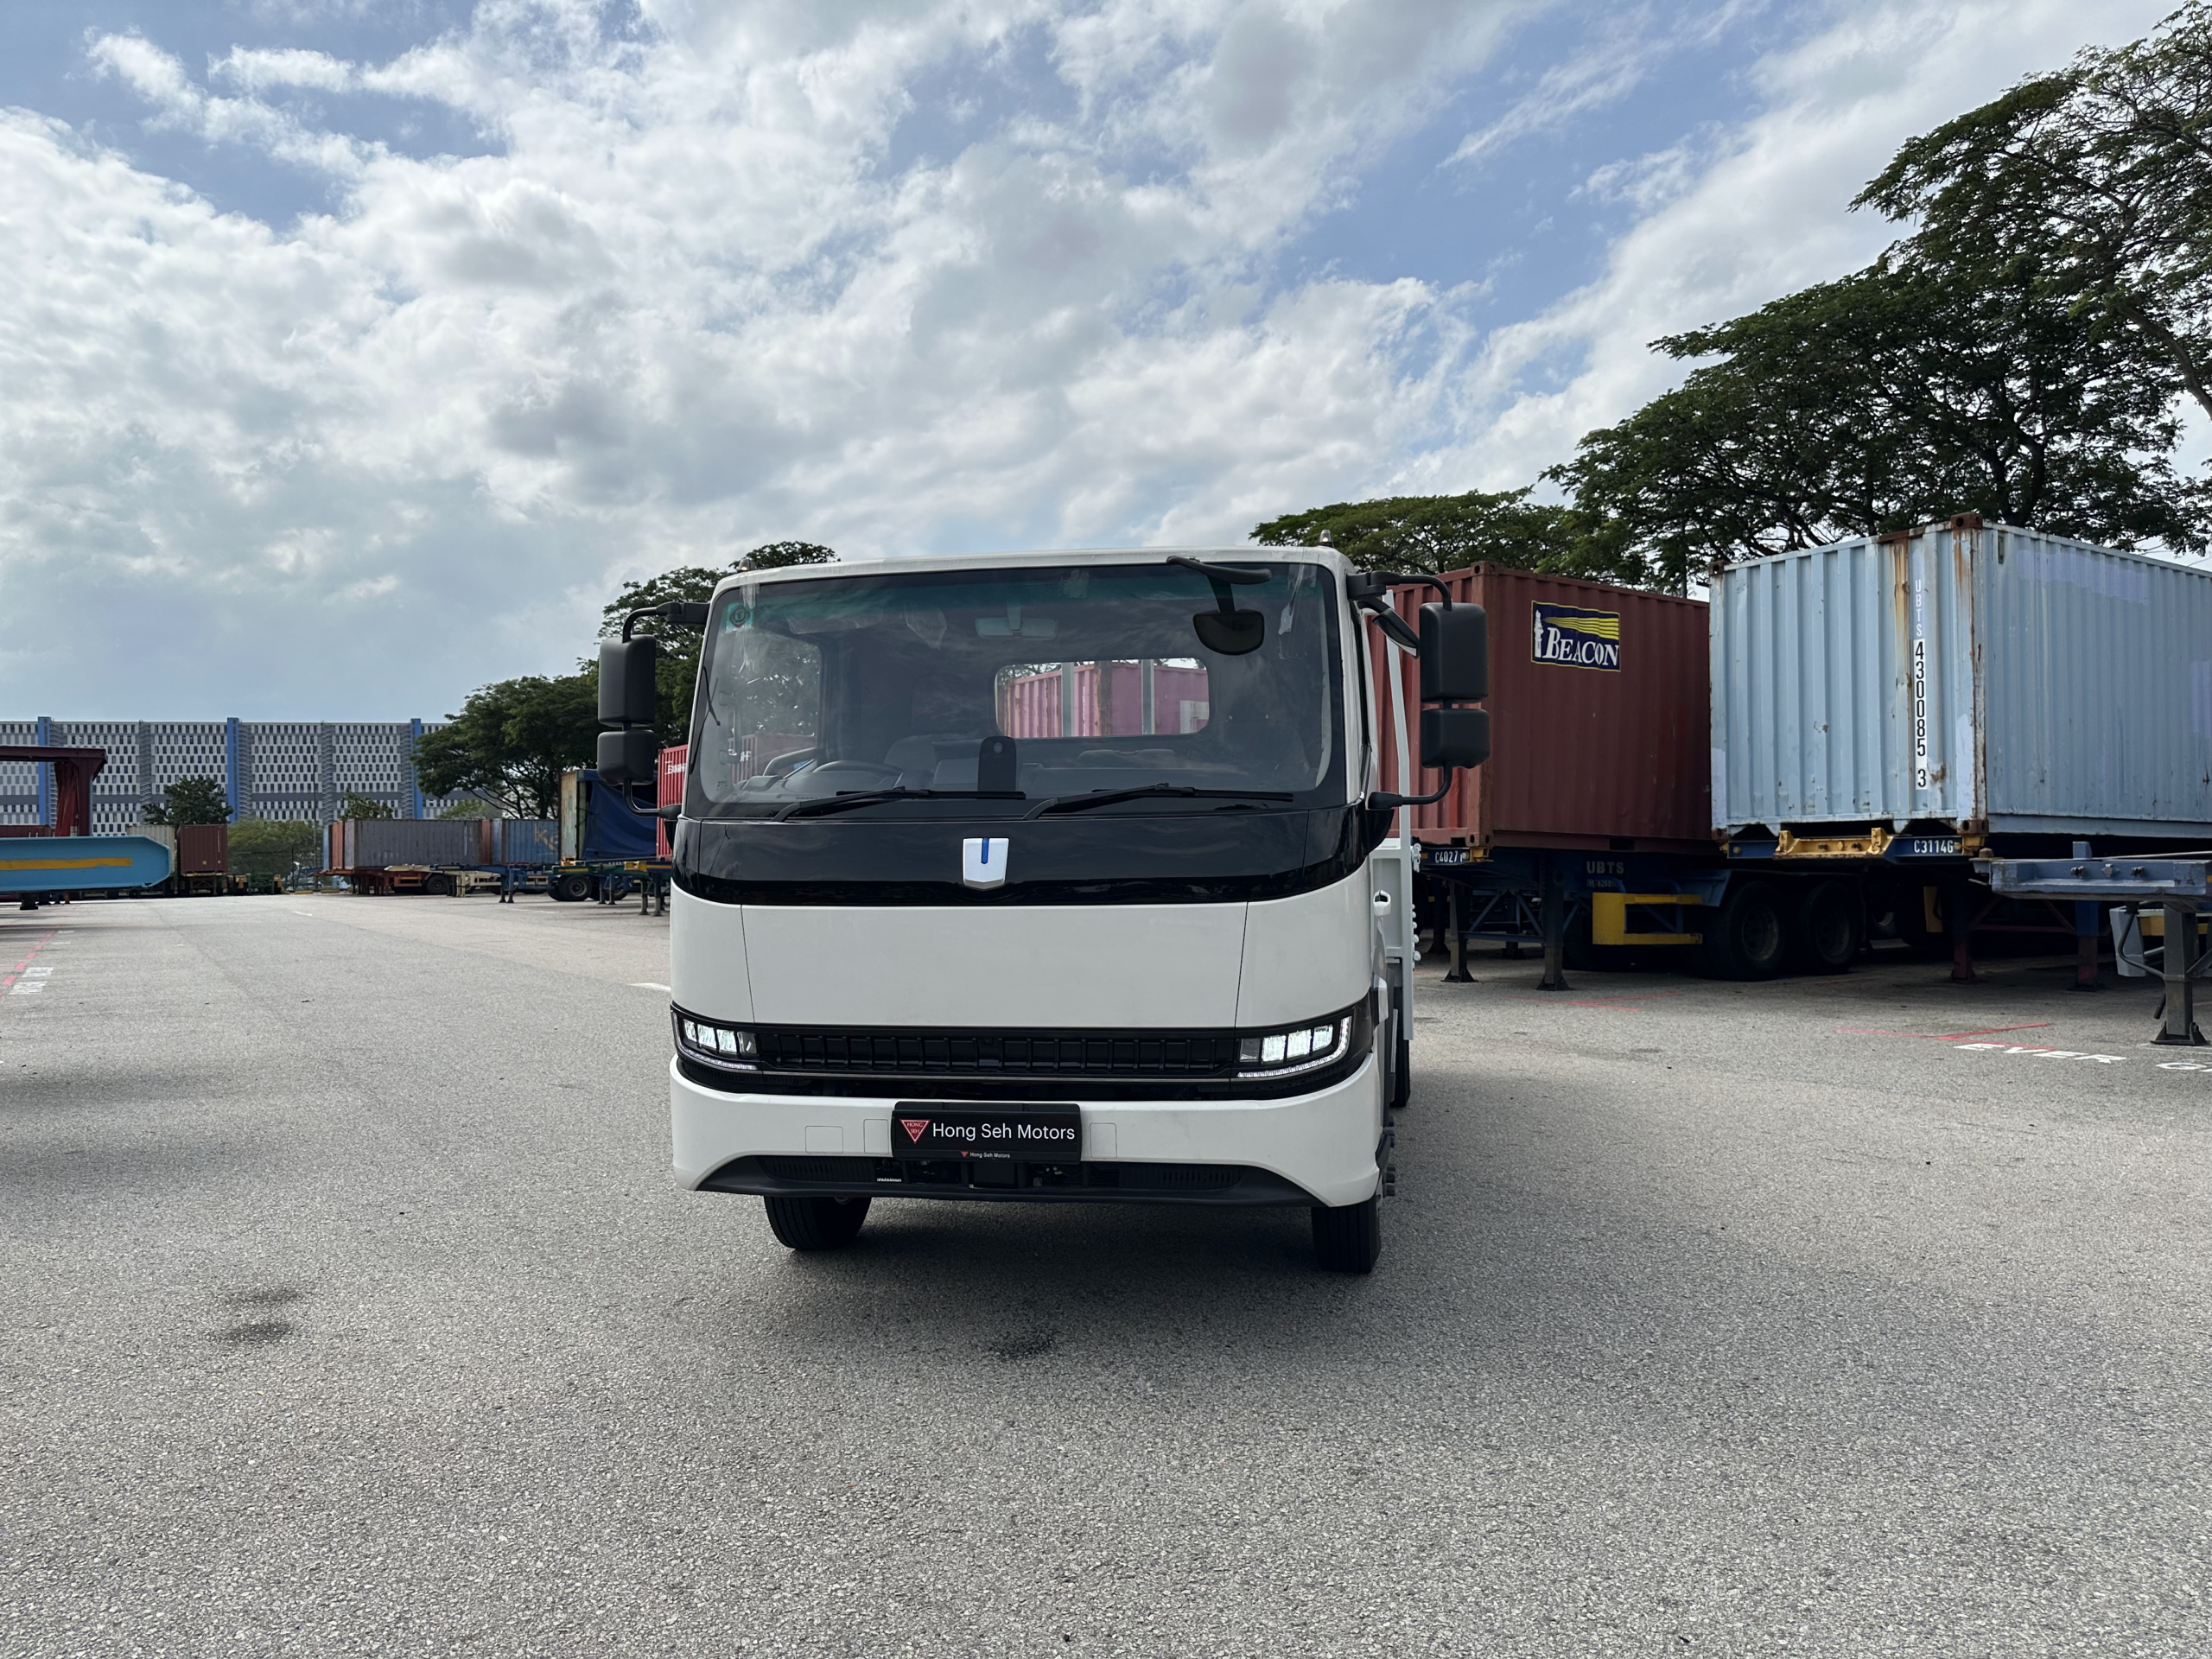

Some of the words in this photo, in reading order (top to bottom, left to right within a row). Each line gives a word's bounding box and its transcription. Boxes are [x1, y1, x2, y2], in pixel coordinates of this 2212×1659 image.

[1542, 626, 1620, 666] BEACON
[1915, 641, 1926, 757] 430085
[1917, 768, 1927, 788] 3
[1914, 839, 1954, 854] C3114G
[1586, 861, 1624, 874] UBTS
[932, 1122, 976, 1141] Hong
[981, 1123, 1012, 1139] Seh
[1017, 1124, 1076, 1140] Motors
